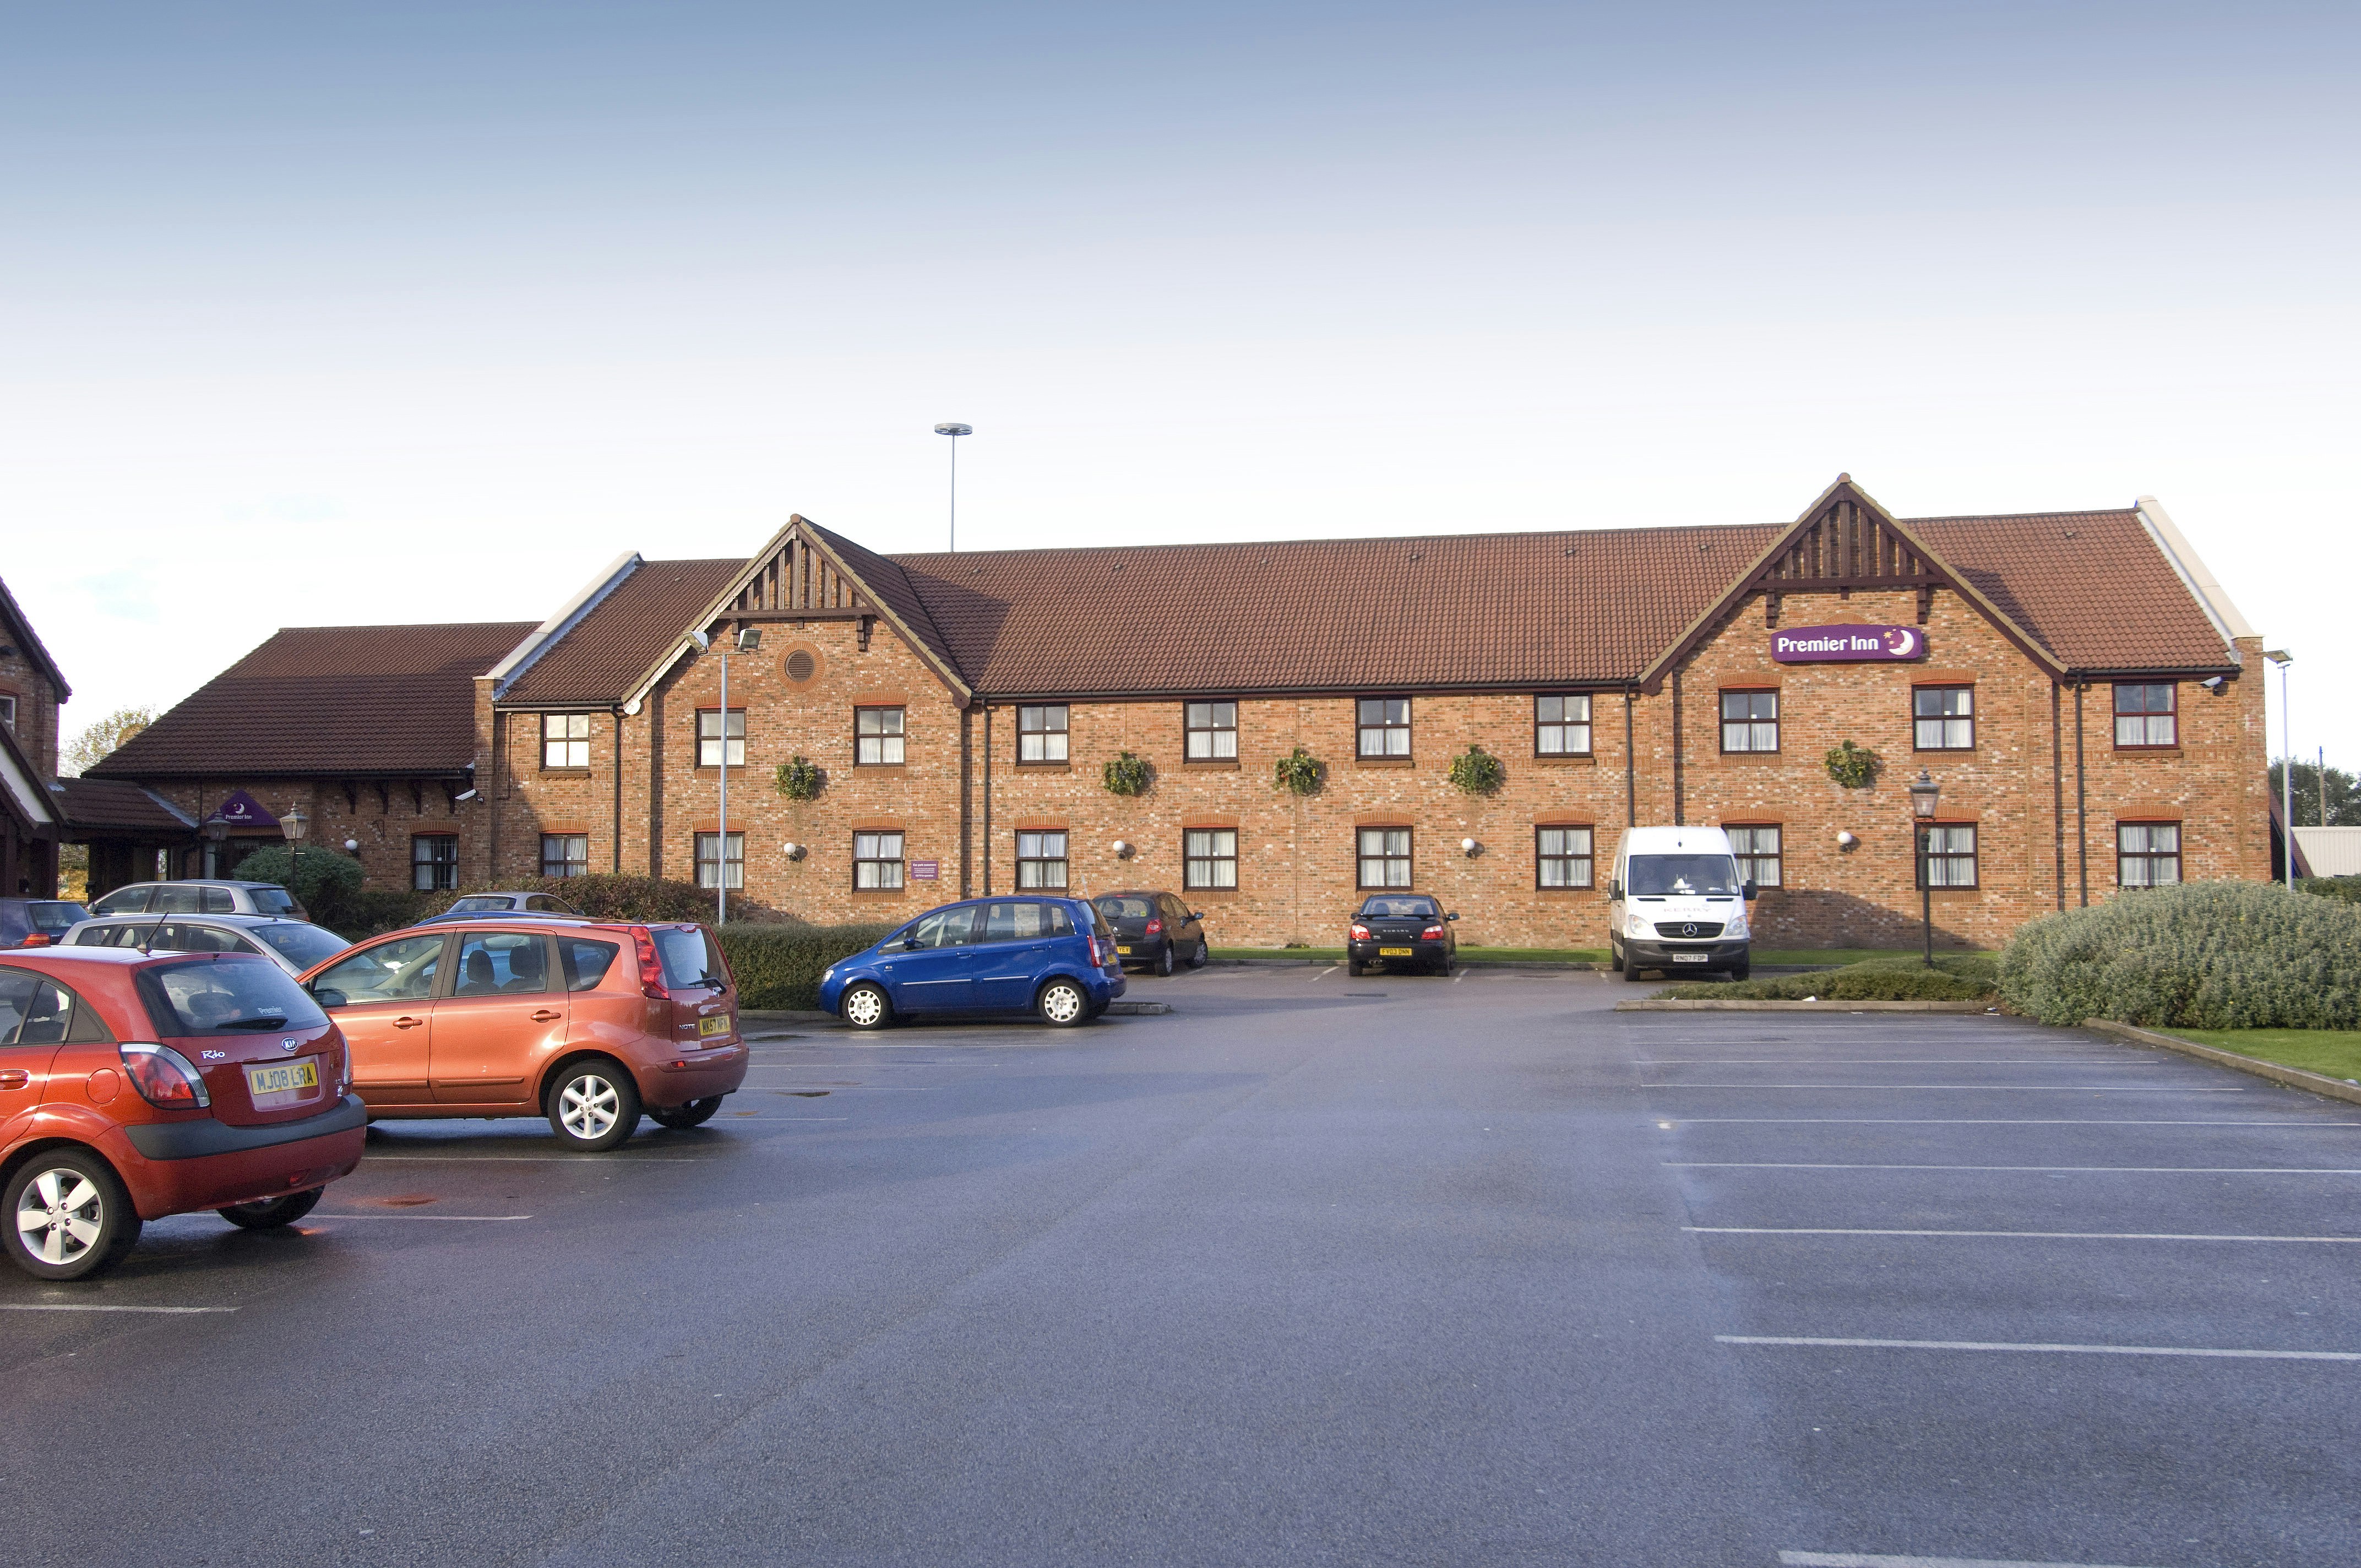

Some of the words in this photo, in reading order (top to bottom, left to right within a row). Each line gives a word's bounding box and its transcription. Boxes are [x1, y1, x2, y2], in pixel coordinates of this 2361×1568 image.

[1777, 636, 1848, 652] Premier
[1851, 635, 1879, 651] Inn
[284, 1039, 297, 1048] KIA
[200, 1050, 225, 1059] Rio
[256, 1070, 289, 1091] MJ08
[290, 1066, 314, 1086] LRA
